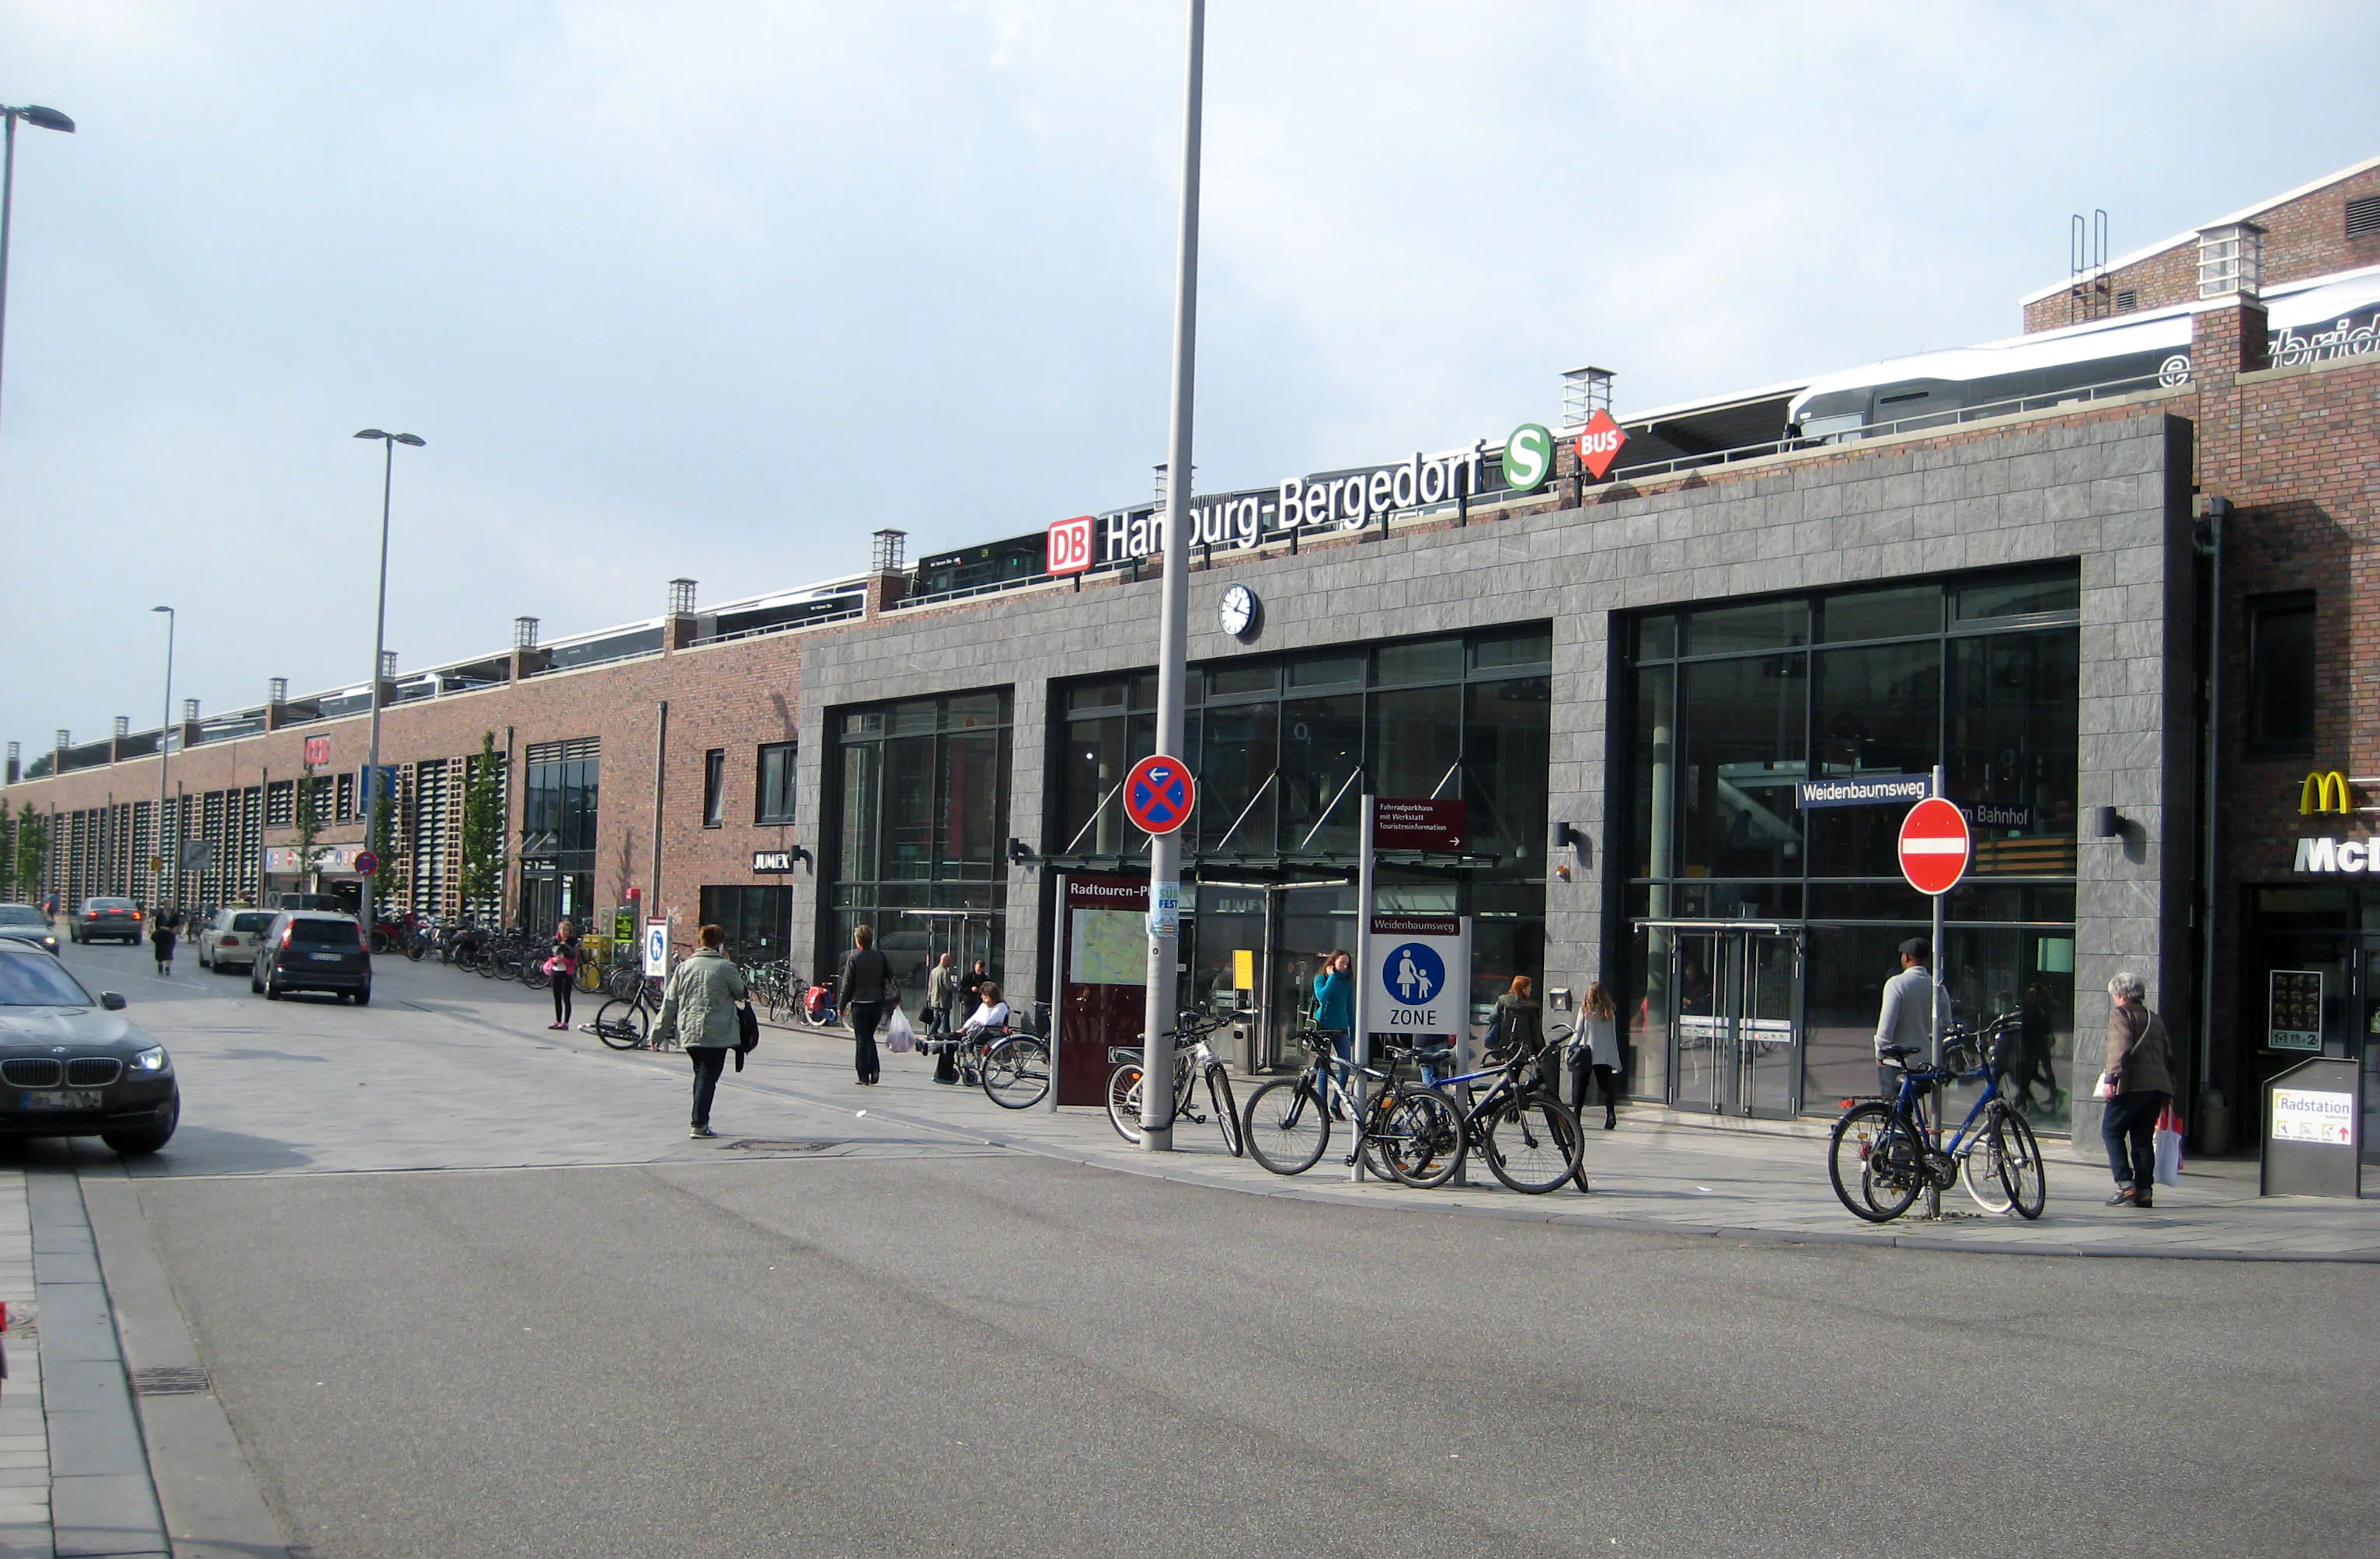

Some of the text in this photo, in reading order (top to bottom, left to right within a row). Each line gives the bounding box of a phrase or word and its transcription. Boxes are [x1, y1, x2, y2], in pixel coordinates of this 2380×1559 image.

[2268, 314, 2380, 369] brid
[1580, 428, 1619, 455] BUS
[1509, 429, 1545, 486] S
[1054, 525, 1086, 565] DB
[1803, 781, 1925, 802] Weidenbaumsweg
[1379, 803, 1434, 812] Fahrradparkhaus
[1960, 805, 2029, 826] m Bahnhof
[1379, 823, 1447, 831] Touristeninformation
[754, 854, 789, 869] JUMEX
[1071, 882, 1151, 896] Radtouren-Pl
[1159, 899, 1178, 909] FEST
[1375, 920, 1455, 932] Weidenbaumsweg
[1390, 1009, 1437, 1025] ZONE
[2281, 1098, 2350, 1114] Radstation
